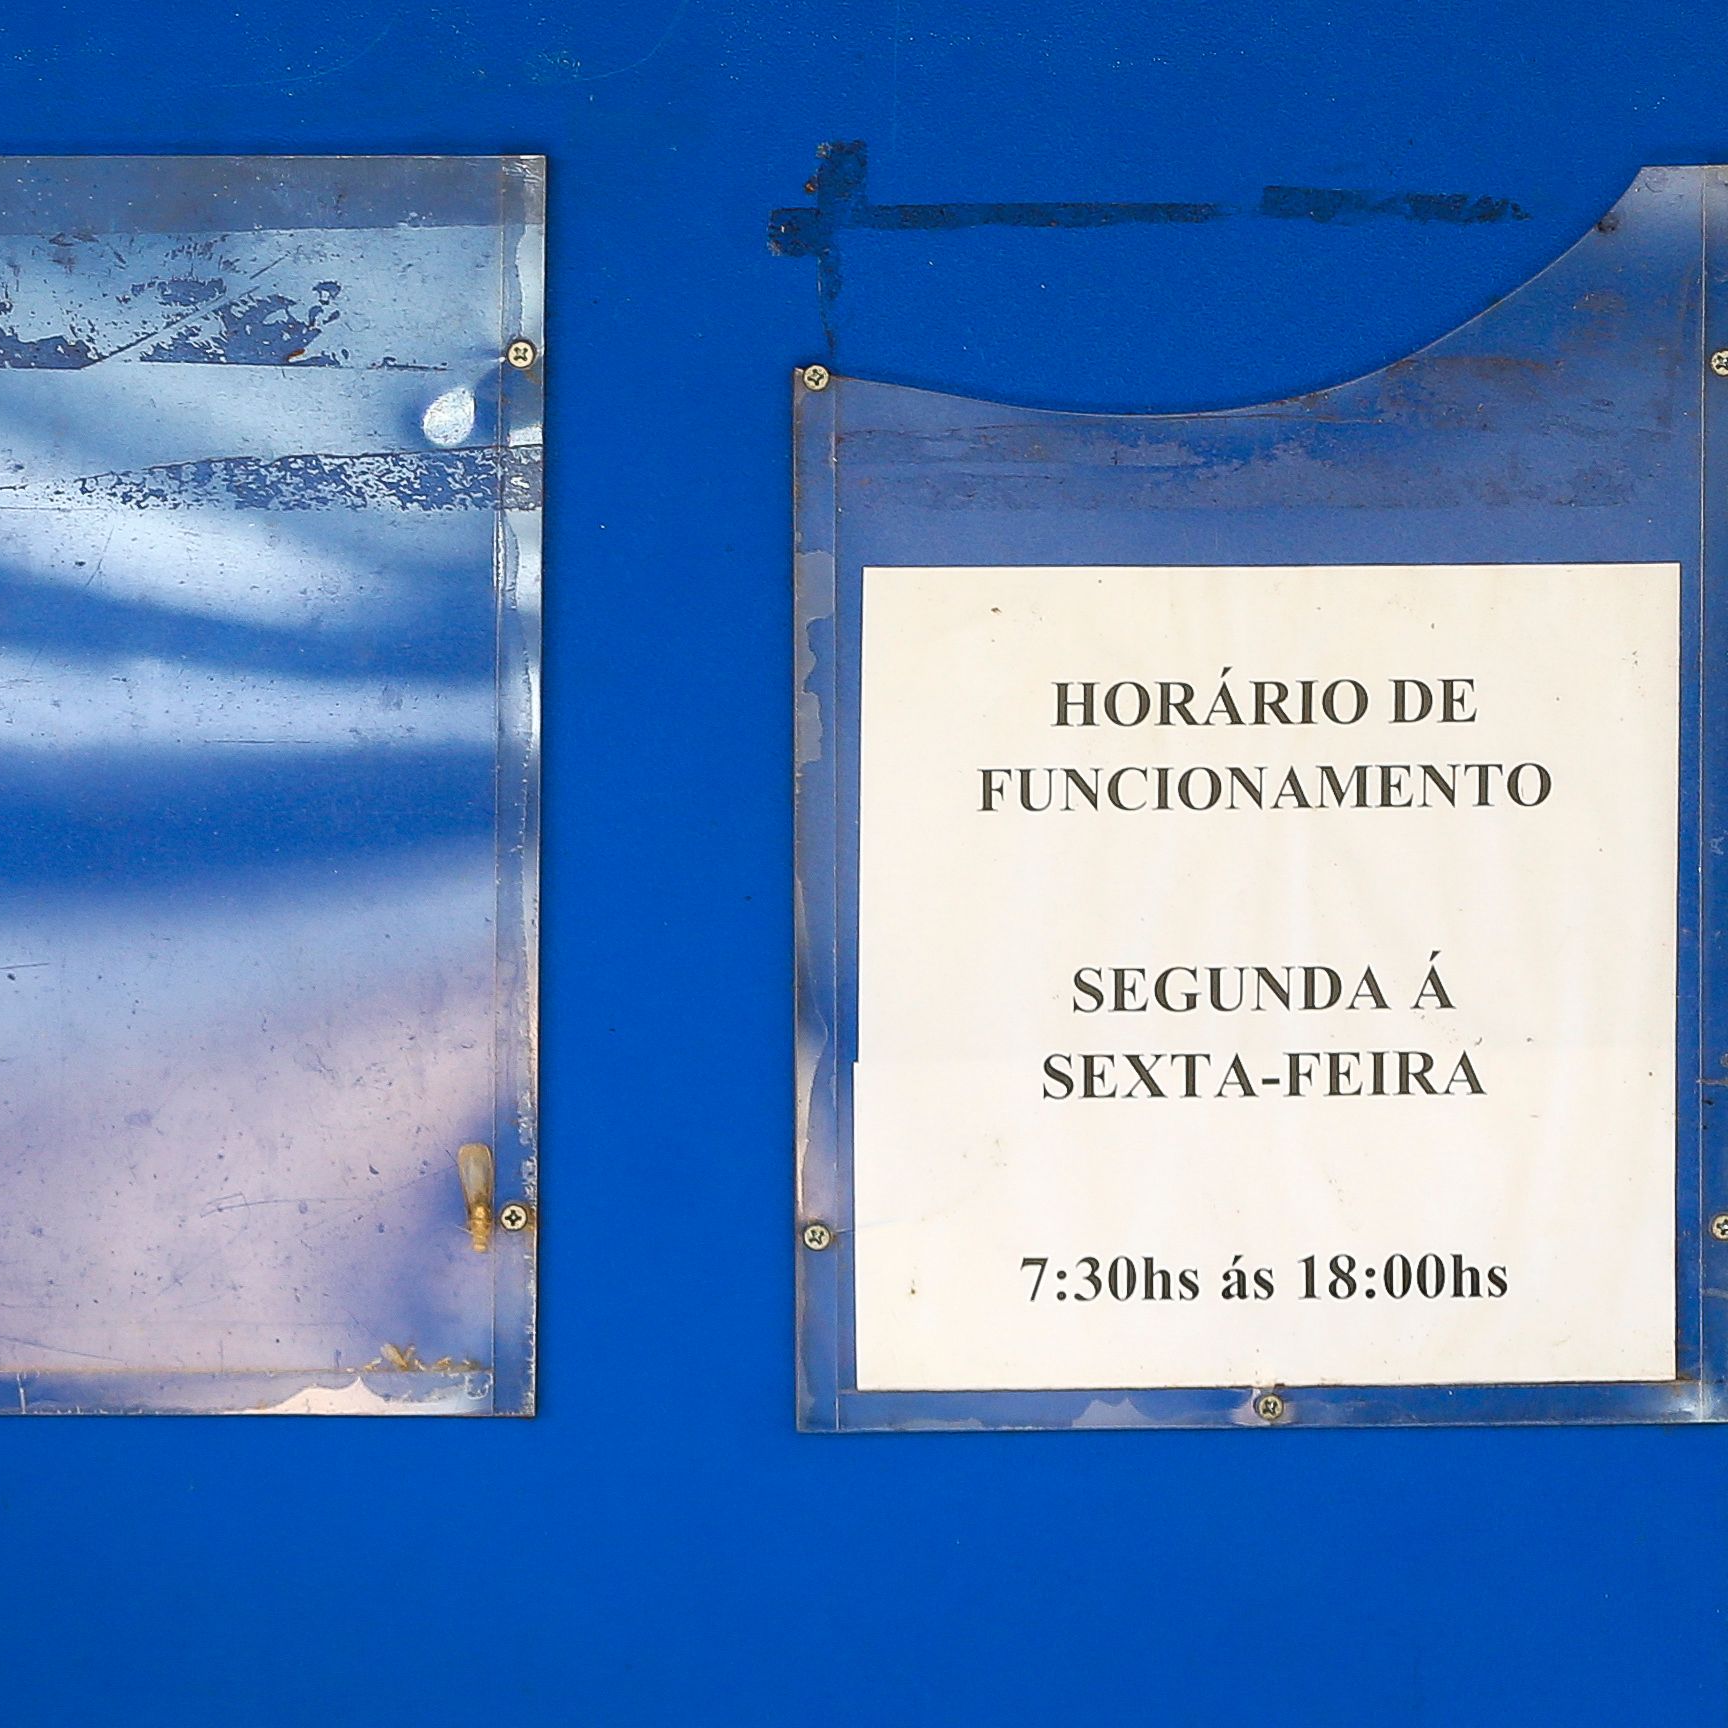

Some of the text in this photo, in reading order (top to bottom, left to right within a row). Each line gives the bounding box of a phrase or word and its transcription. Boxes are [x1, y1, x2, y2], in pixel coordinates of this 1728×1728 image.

[1051, 667, 1477, 728] HORÁRIO DE
[977, 761, 1553, 813] FUNCIONAMENTO
[1072, 951, 1457, 1015] SEGUNDA Á
[1041, 1049, 1487, 1100] SEXTA-FEIRA
[1019, 1252, 1510, 1304] 7:30hs ás 18:00hs
